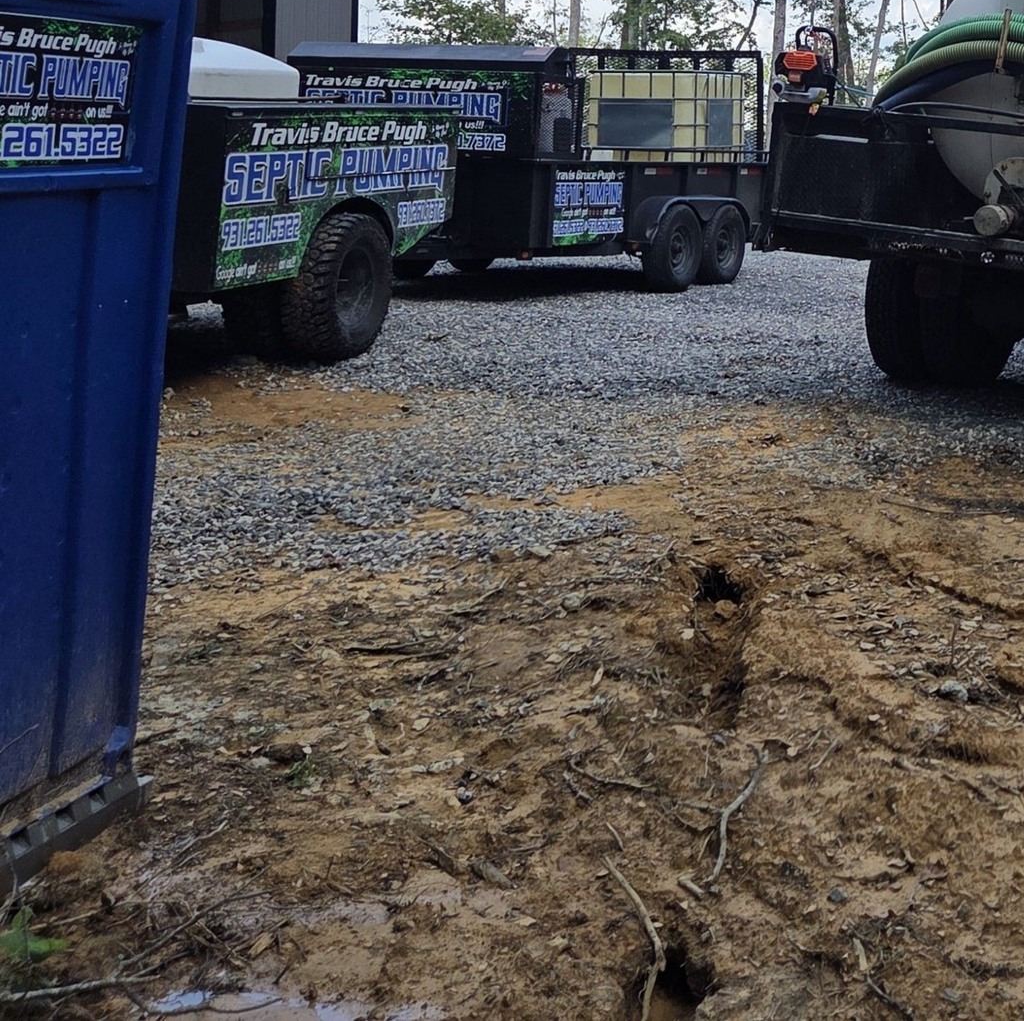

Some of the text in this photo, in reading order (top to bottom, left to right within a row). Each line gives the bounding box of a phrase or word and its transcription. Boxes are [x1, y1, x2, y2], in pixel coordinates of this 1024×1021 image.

[16, 27, 75, 50] Bruce
[74, 33, 118, 58] Pugh
[37, 54, 130, 108] PUMPING
[305, 74, 477, 92] Travis Bruce Pugh
[8, 102, 31, 117] ain't
[31, 103, 49, 120] got
[85, 107, 97, 118] on
[97, 105, 114, 118] us!!!
[391, 90, 502, 122] PUMPING
[251, 120, 427, 146] Travis Bruce Pugh
[222, 144, 448, 207] SEPTIC PUMPING
[576, 170, 597, 180] Bruce
[597, 170, 616, 182] Pugh
[554, 182, 623, 208] SEPTIC PUMPING
[221, 212, 301, 251] 931.261.5322
